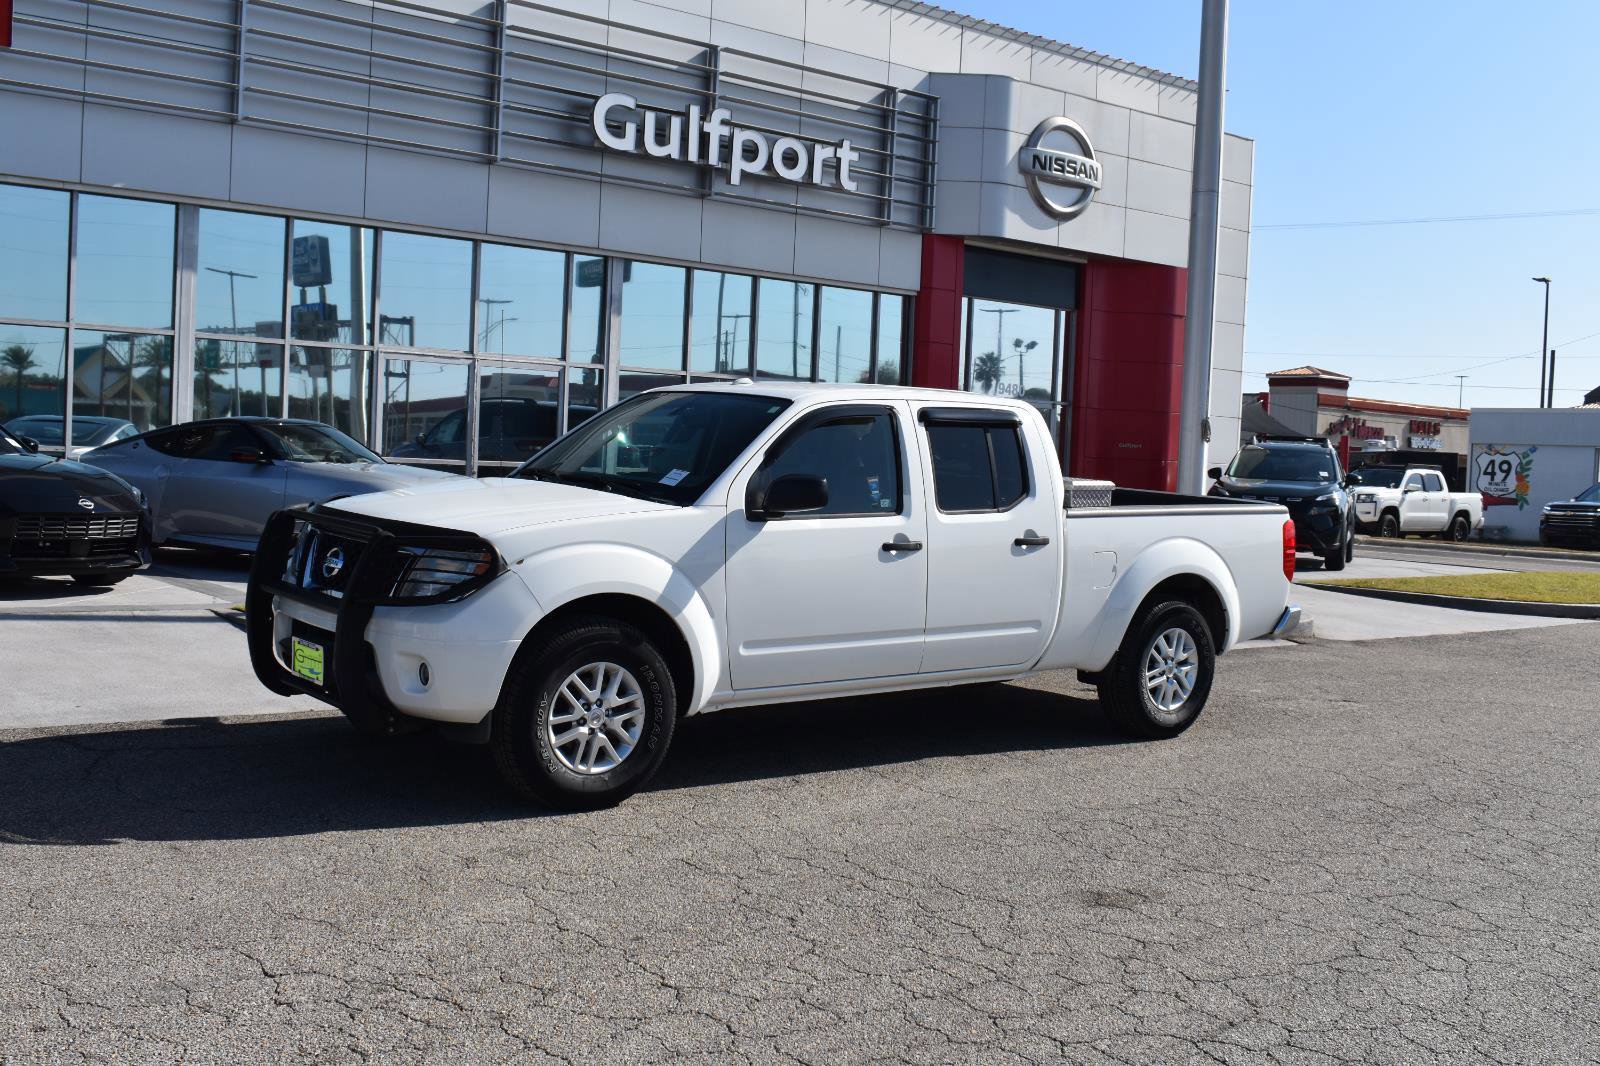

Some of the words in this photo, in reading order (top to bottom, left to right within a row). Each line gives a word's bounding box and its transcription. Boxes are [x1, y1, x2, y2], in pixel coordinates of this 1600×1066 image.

[592, 92, 860, 192] Gulfport
[1032, 154, 1099, 182] NISSAN
[1482, 459, 1513, 482] 49
[639, 664, 663, 752] IRONMAN
